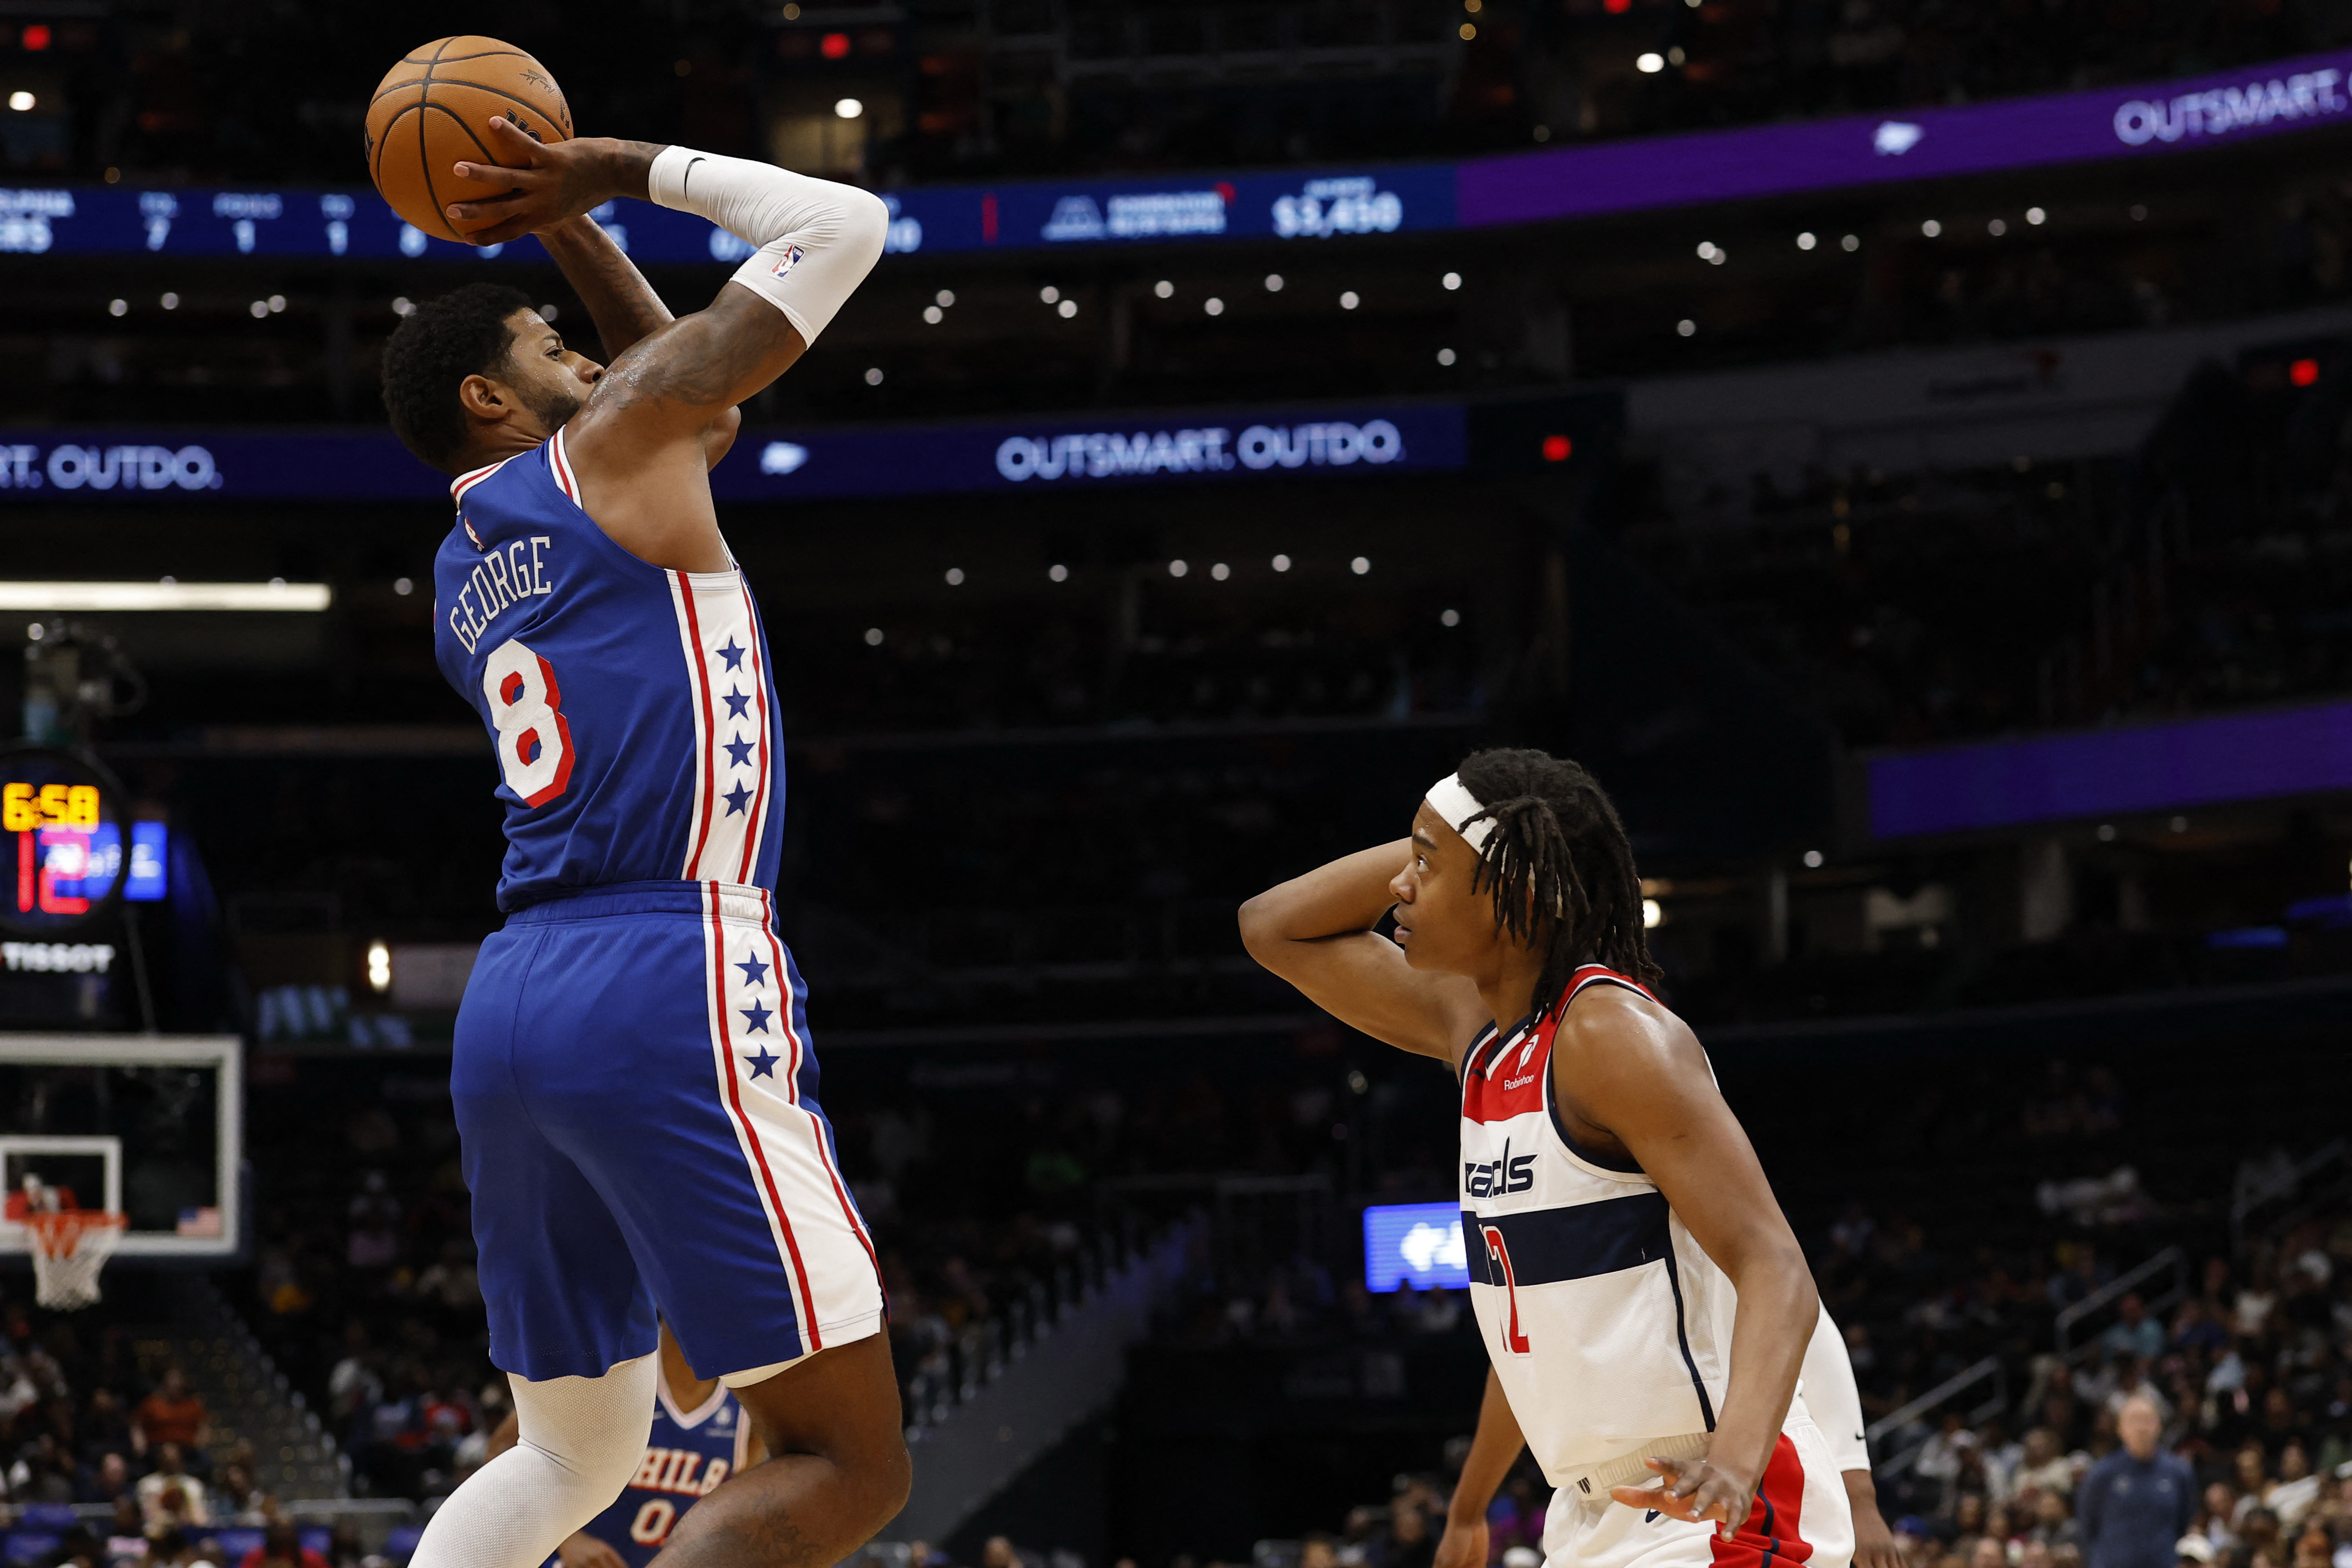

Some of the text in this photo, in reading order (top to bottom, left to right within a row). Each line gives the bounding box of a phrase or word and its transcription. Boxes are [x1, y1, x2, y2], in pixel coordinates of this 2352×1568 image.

[2113, 69, 2347, 146] OUTSMART.
[793, 248, 803, 257] NBA
[47, 444, 223, 490] OUTDO.
[996, 419, 1406, 482] OUTSMART. OUTDO.
[449, 536, 552, 654] GEORGE
[483, 638, 575, 809] 8
[3, 782, 100, 834] 6:58
[1, 941, 116, 973] TISSOT
